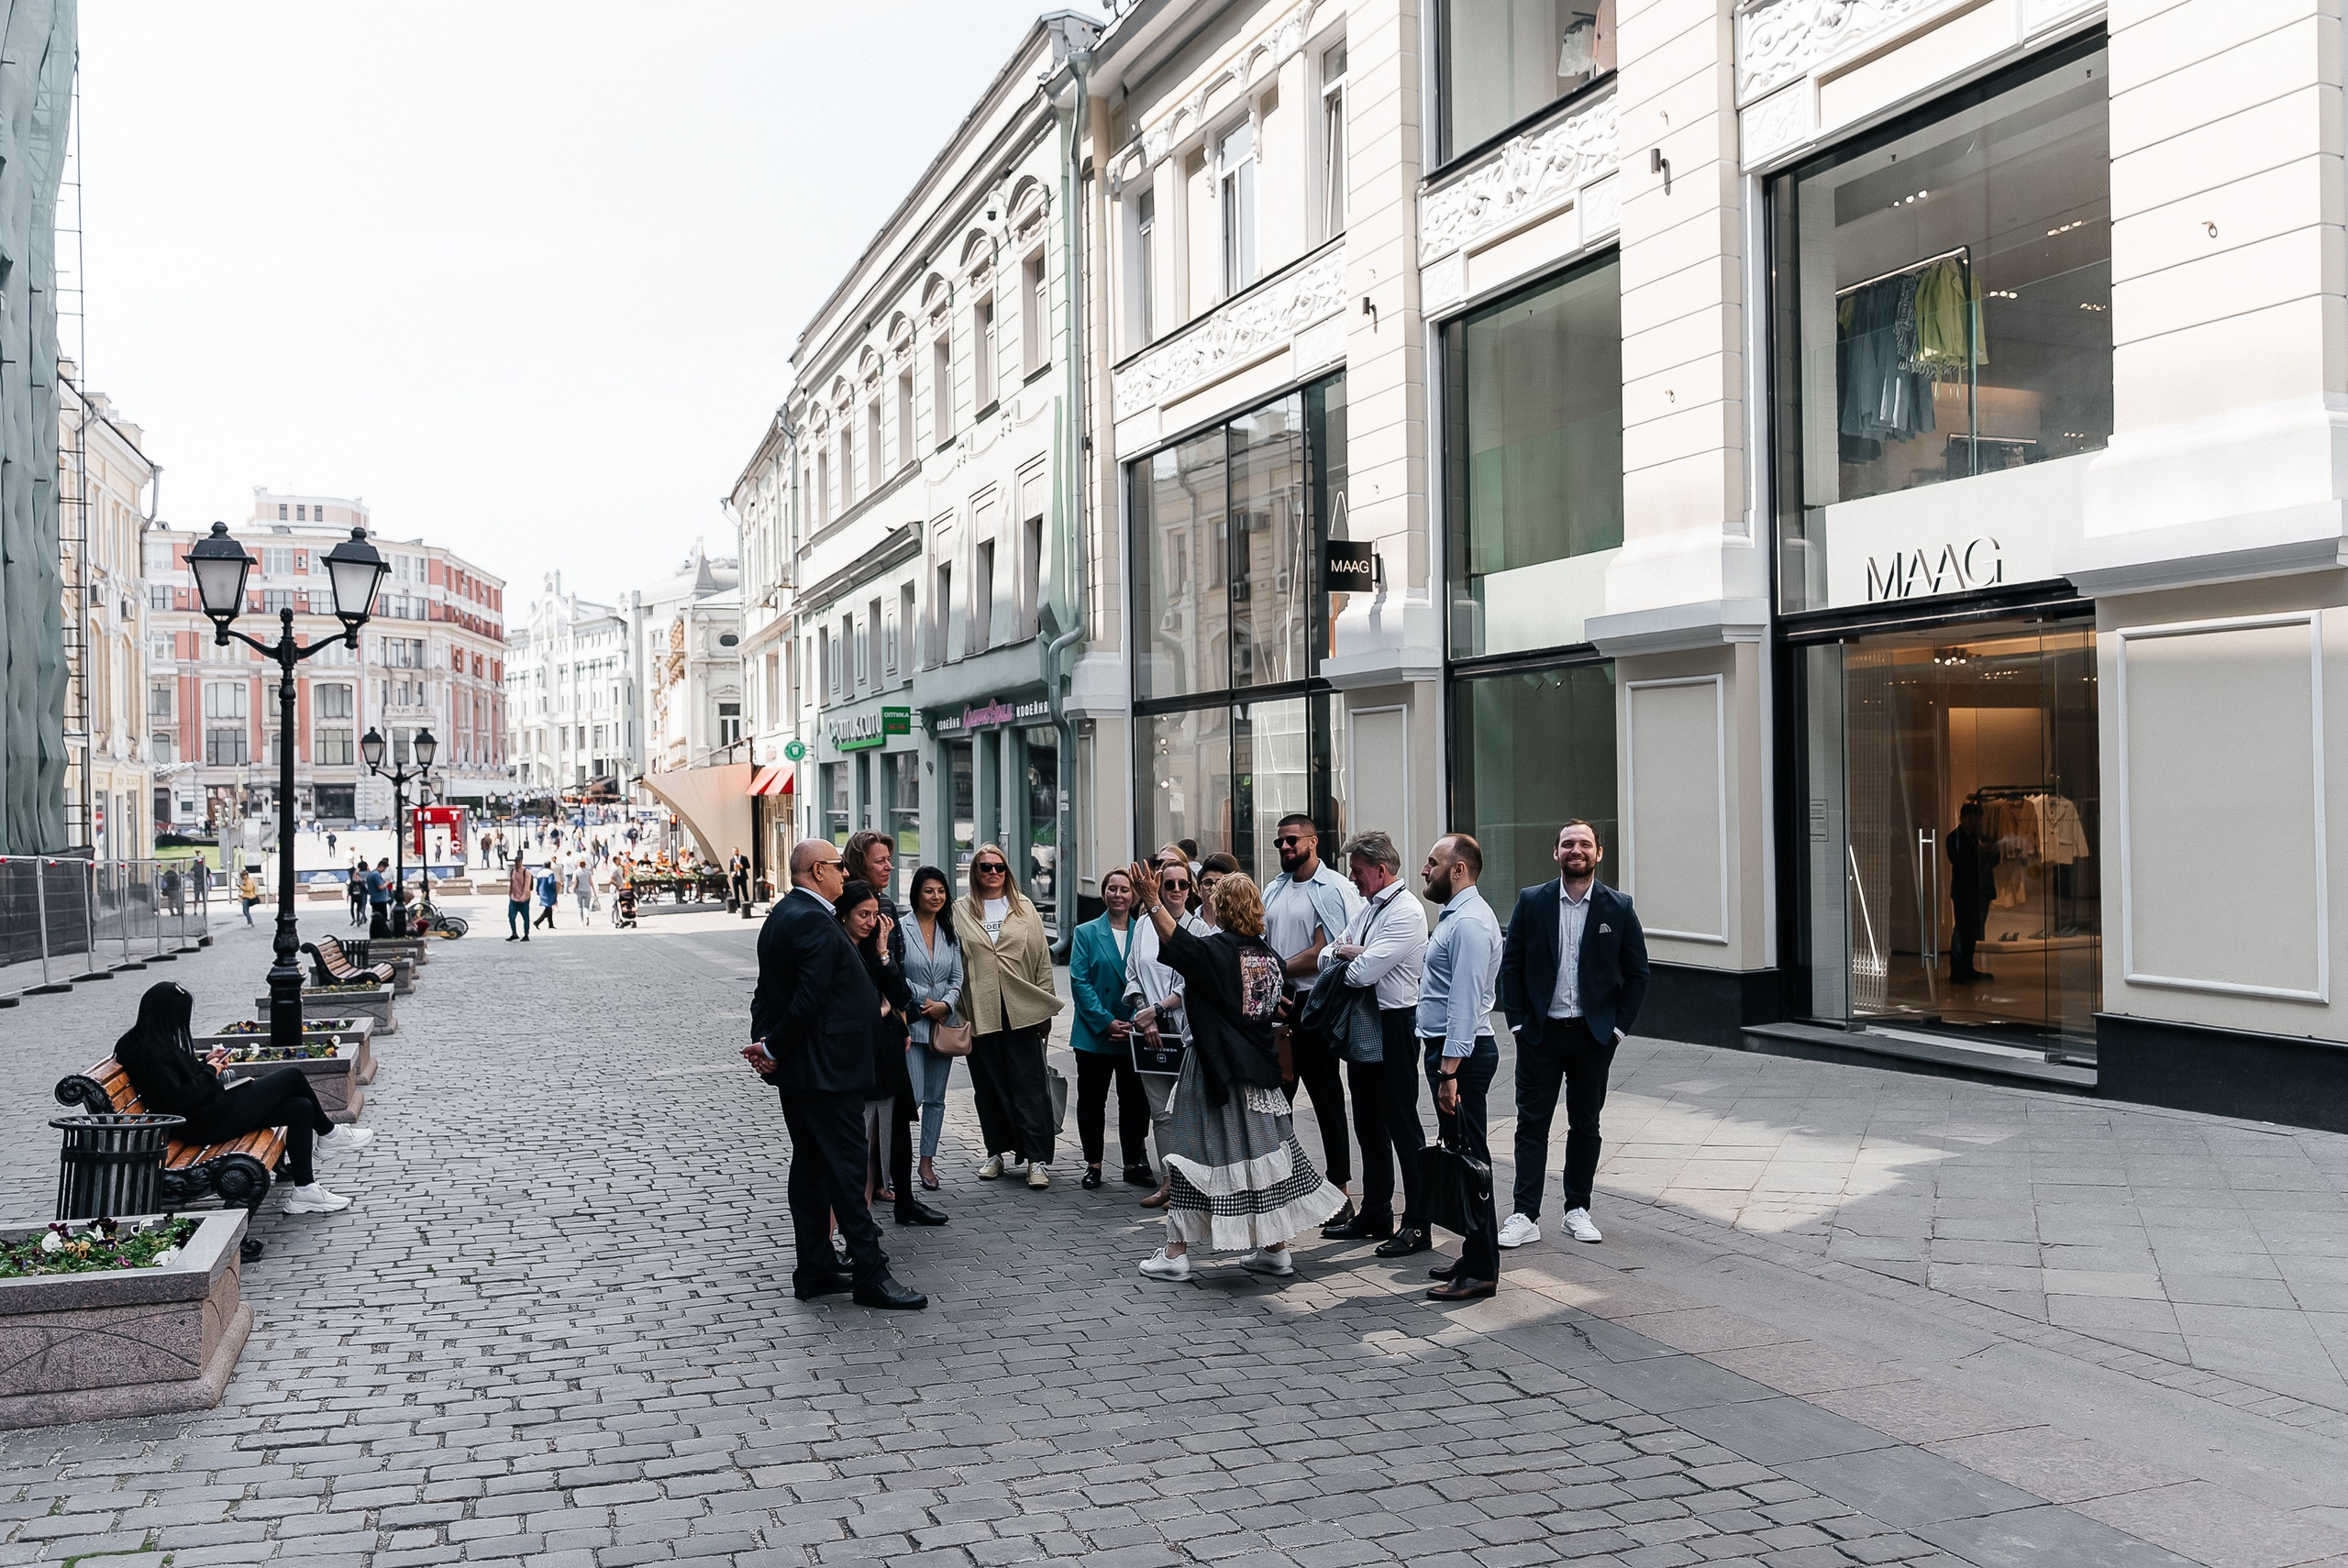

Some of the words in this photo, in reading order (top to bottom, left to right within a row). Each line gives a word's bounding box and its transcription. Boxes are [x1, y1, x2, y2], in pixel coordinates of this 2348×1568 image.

[1331, 559, 1369, 573] MAAG
[1866, 535, 2002, 602] MAAG
[1015, 701, 1048, 717] КОФЕЙНЯ
